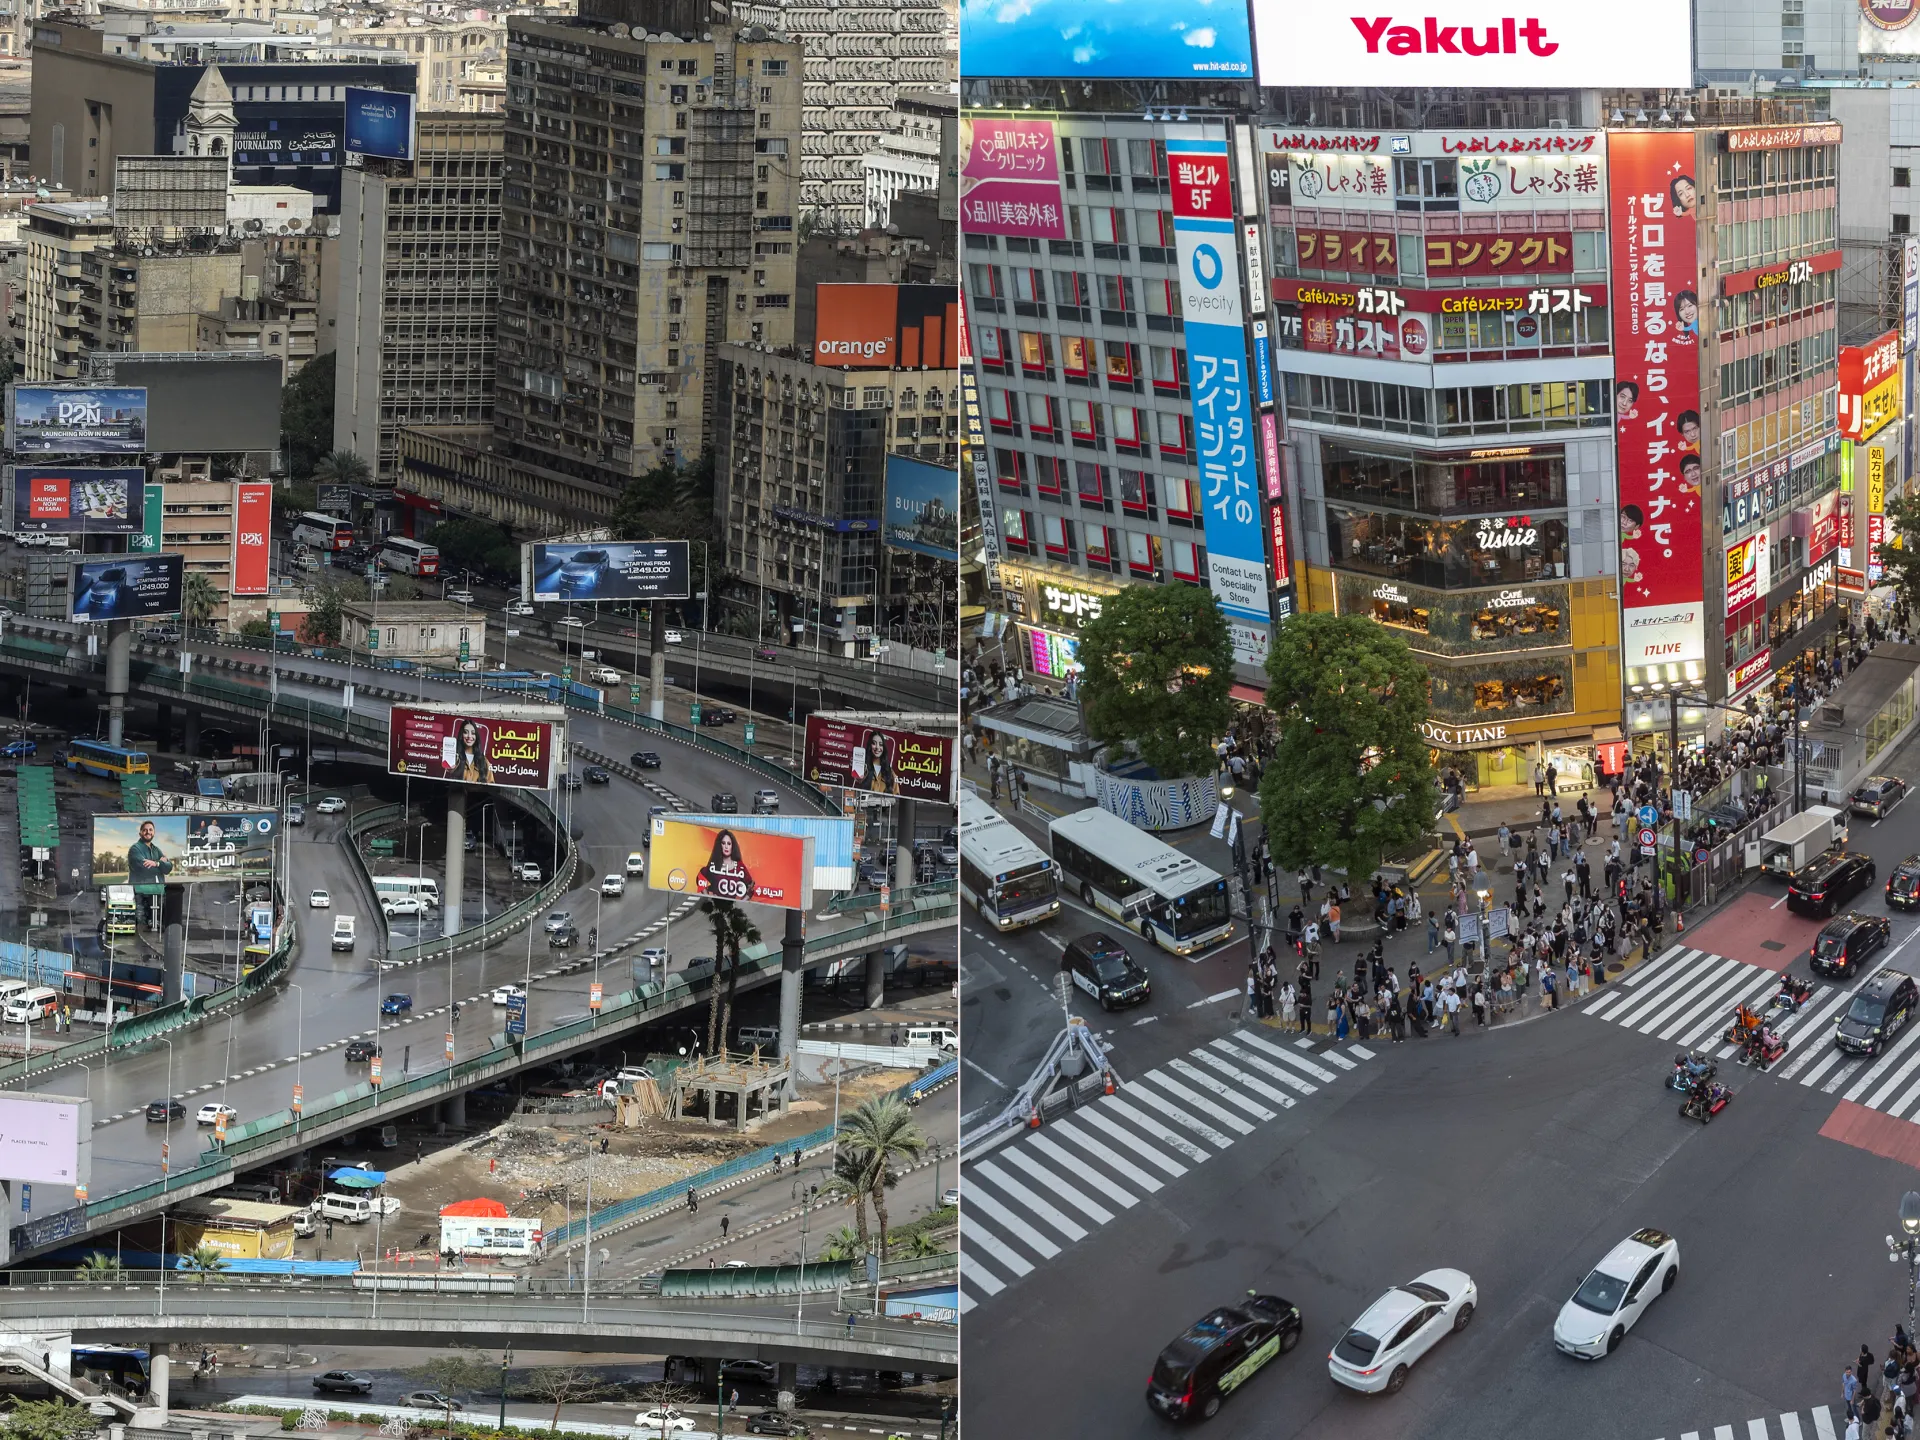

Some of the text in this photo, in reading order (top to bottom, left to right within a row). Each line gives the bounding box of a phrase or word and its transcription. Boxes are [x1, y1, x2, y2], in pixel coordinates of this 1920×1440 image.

[1863, 7, 1886, 29] EXCITING
[1886, 7, 1920, 30] AMUSEMENT
[1350, 17, 1560, 57] Yakult
[1193, 62, 1247, 73] www.hit-ad.co.jp
[234, 140, 282, 151] JOURNALISTS
[993, 131, 1050, 152] 品川スキン
[1273, 132, 1381, 152] しゃぶしゃぶバイキング
[1441, 135, 1596, 153] しゃぶしゃぶバイキング
[997, 153, 1046, 172] クリニック
[1178, 162, 1220, 186] 当ビル
[1271, 169, 1288, 187] 9F
[1326, 165, 1388, 196] しゃぶ葉
[1510, 163, 1599, 195] しゃぶ葉
[1191, 189, 1212, 210] 5F
[973, 201, 1059, 229] 品川美容外科
[1298, 233, 1395, 264] プライス
[1427, 236, 1568, 266] コンタクト
[1249, 246, 1261, 301] 献血ルーム
[1789, 260, 1813, 286] ガスト
[1188, 295, 1234, 315] eyecity
[1357, 287, 1406, 316] ガスト
[1528, 288, 1592, 315] ガスト
[1281, 316, 1302, 336] 7F
[1307, 317, 1333, 335] Café
[1335, 316, 1394, 354] ガスト
[1519, 325, 1536, 333] ガスト
[818, 338, 887, 360] orange
[1405, 335, 1426, 345] ガスト
[1863, 340, 1898, 385] スギ薬局
[971, 435, 983, 443] 5F
[1193, 355, 1230, 520] アイシティ
[1222, 358, 1253, 524] コンタクトの
[1828, 432, 1840, 451] 4F
[974, 453, 985, 461] 3F
[1266, 431, 1279, 497] 品川美容外科 4F
[1754, 469, 1770, 488] 抜毛
[1773, 460, 1788, 478] 発毛
[1871, 449, 1882, 510] 処方せん 3F
[978, 478, 989, 496] 内科
[895, 496, 945, 519] BUILT TO
[1723, 491, 1760, 533] AGA
[894, 529, 915, 542] 16094
[1814, 517, 1834, 543] アコム
[1841, 518, 1849, 538] アコム
[1475, 527, 1538, 550] Ushi8
[1212, 562, 1263, 582] Contact Lens
[1729, 550, 1741, 580] 薬
[1220, 577, 1257, 594] Speciality
[1803, 559, 1832, 596] LUSH
[1229, 592, 1250, 605] Store
[1487, 597, 1536, 609] L'OCCITANE
[1727, 581, 1756, 608] サンドラッグ
[1644, 642, 1682, 656] 17LIVE
[493, 725, 540, 742] أسهل
[491, 743, 540, 762] أبلكيشن
[899, 739, 943, 756] أسهل
[505, 763, 517, 775] كل
[517, 766, 539, 777] بيعمل
[897, 756, 942, 775] أبلكيشن
[910, 777, 921, 788] كل
[921, 779, 942, 791] بيعمل
[1135, 852, 1175, 869] 32332
[669, 873, 685, 884] dmc
[762, 888, 783, 897] الحياة
[210, 1239, 241, 1250] Market
